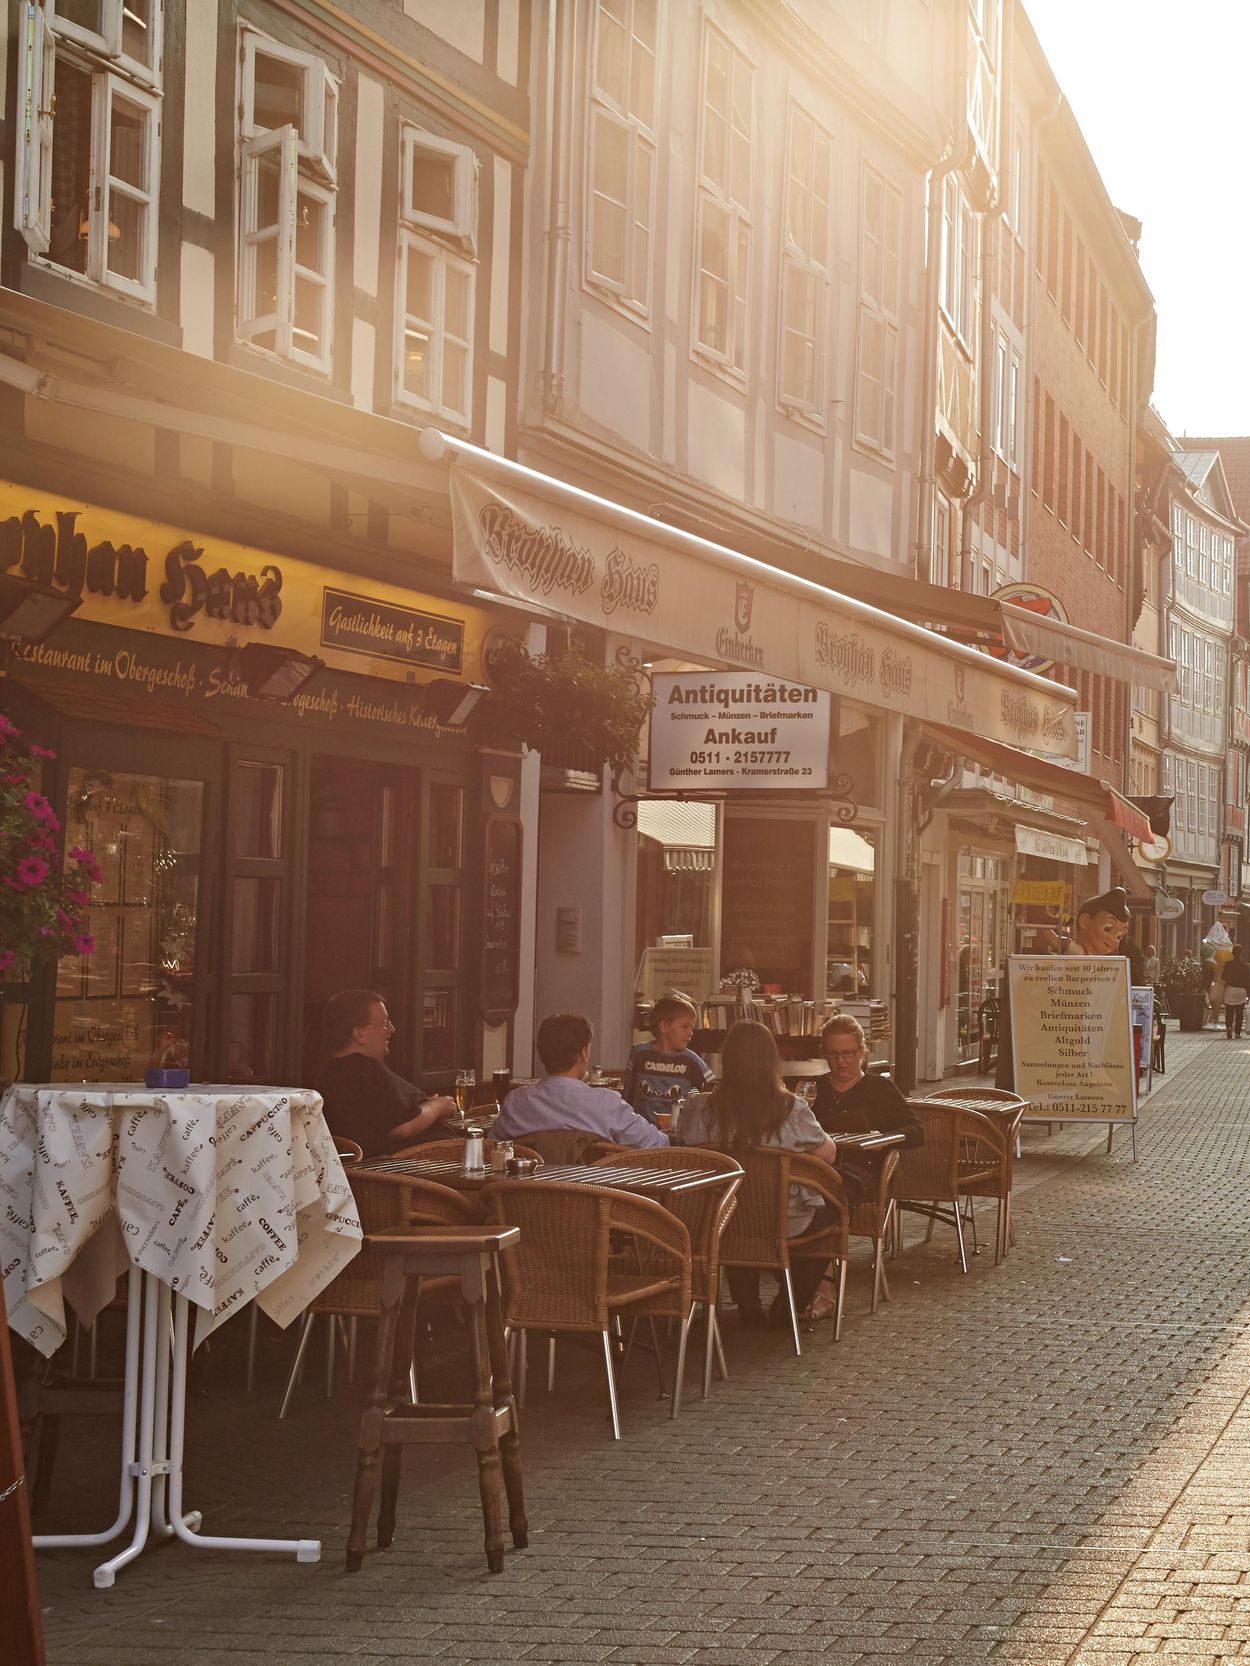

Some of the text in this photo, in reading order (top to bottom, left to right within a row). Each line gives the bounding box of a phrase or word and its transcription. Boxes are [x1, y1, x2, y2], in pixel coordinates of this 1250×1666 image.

[329, 606, 458, 660] Gastlichkeit auf 3 Etagen
[95, 655, 113, 675] im
[114, 650, 196, 692] Obergeschoß
[346, 695, 407, 727] Historisches
[668, 683, 818, 708] Antiquitäten
[670, 711, 814, 721] Schmuck Münzen Briefmarken
[703, 727, 778, 745] Ankauf
[690, 751, 791, 764] 0511 2157777
[669, 767, 813, 776] Günther Lamers Kramerstraße 23
[1018, 963, 1034, 971] Wir
[1035, 963, 1063, 971] kaufen
[1092, 964, 1120, 973] Jahren
[1047, 986, 1093, 995] Schmuck
[1050, 998, 1090, 1007] Münzen
[1040, 1010, 1103, 1020] Briefmarken
[1040, 1023, 1103, 1034] Antiquitäten
[1054, 1035, 1090, 1046] Altgold
[1057, 1048, 1088, 1057] Silber
[1020, 1060, 1070, 1069] Sammlungen
[1087, 1061, 1124, 1069] Nachlässe
[1055, 1070, 1074, 1079] jeder
[1078, 1080, 1112, 1089] Angebote
[1075, 1093, 1104, 1101] Lamers
[1052, 1103, 1097, 1114] 0511-215
[1100, 1104, 1112, 1114] 77
[1114, 1105, 1127, 1115] 77
[240, 1097, 288, 1142] CAPPUCCINO
[181, 1146, 201, 1176] kaffee
[163, 1171, 196, 1195] COFFEE
[56, 1180, 79, 1220] KAFFEE
[259, 1217, 287, 1251] COFFEE
[254, 1254, 276, 1276] caffè
